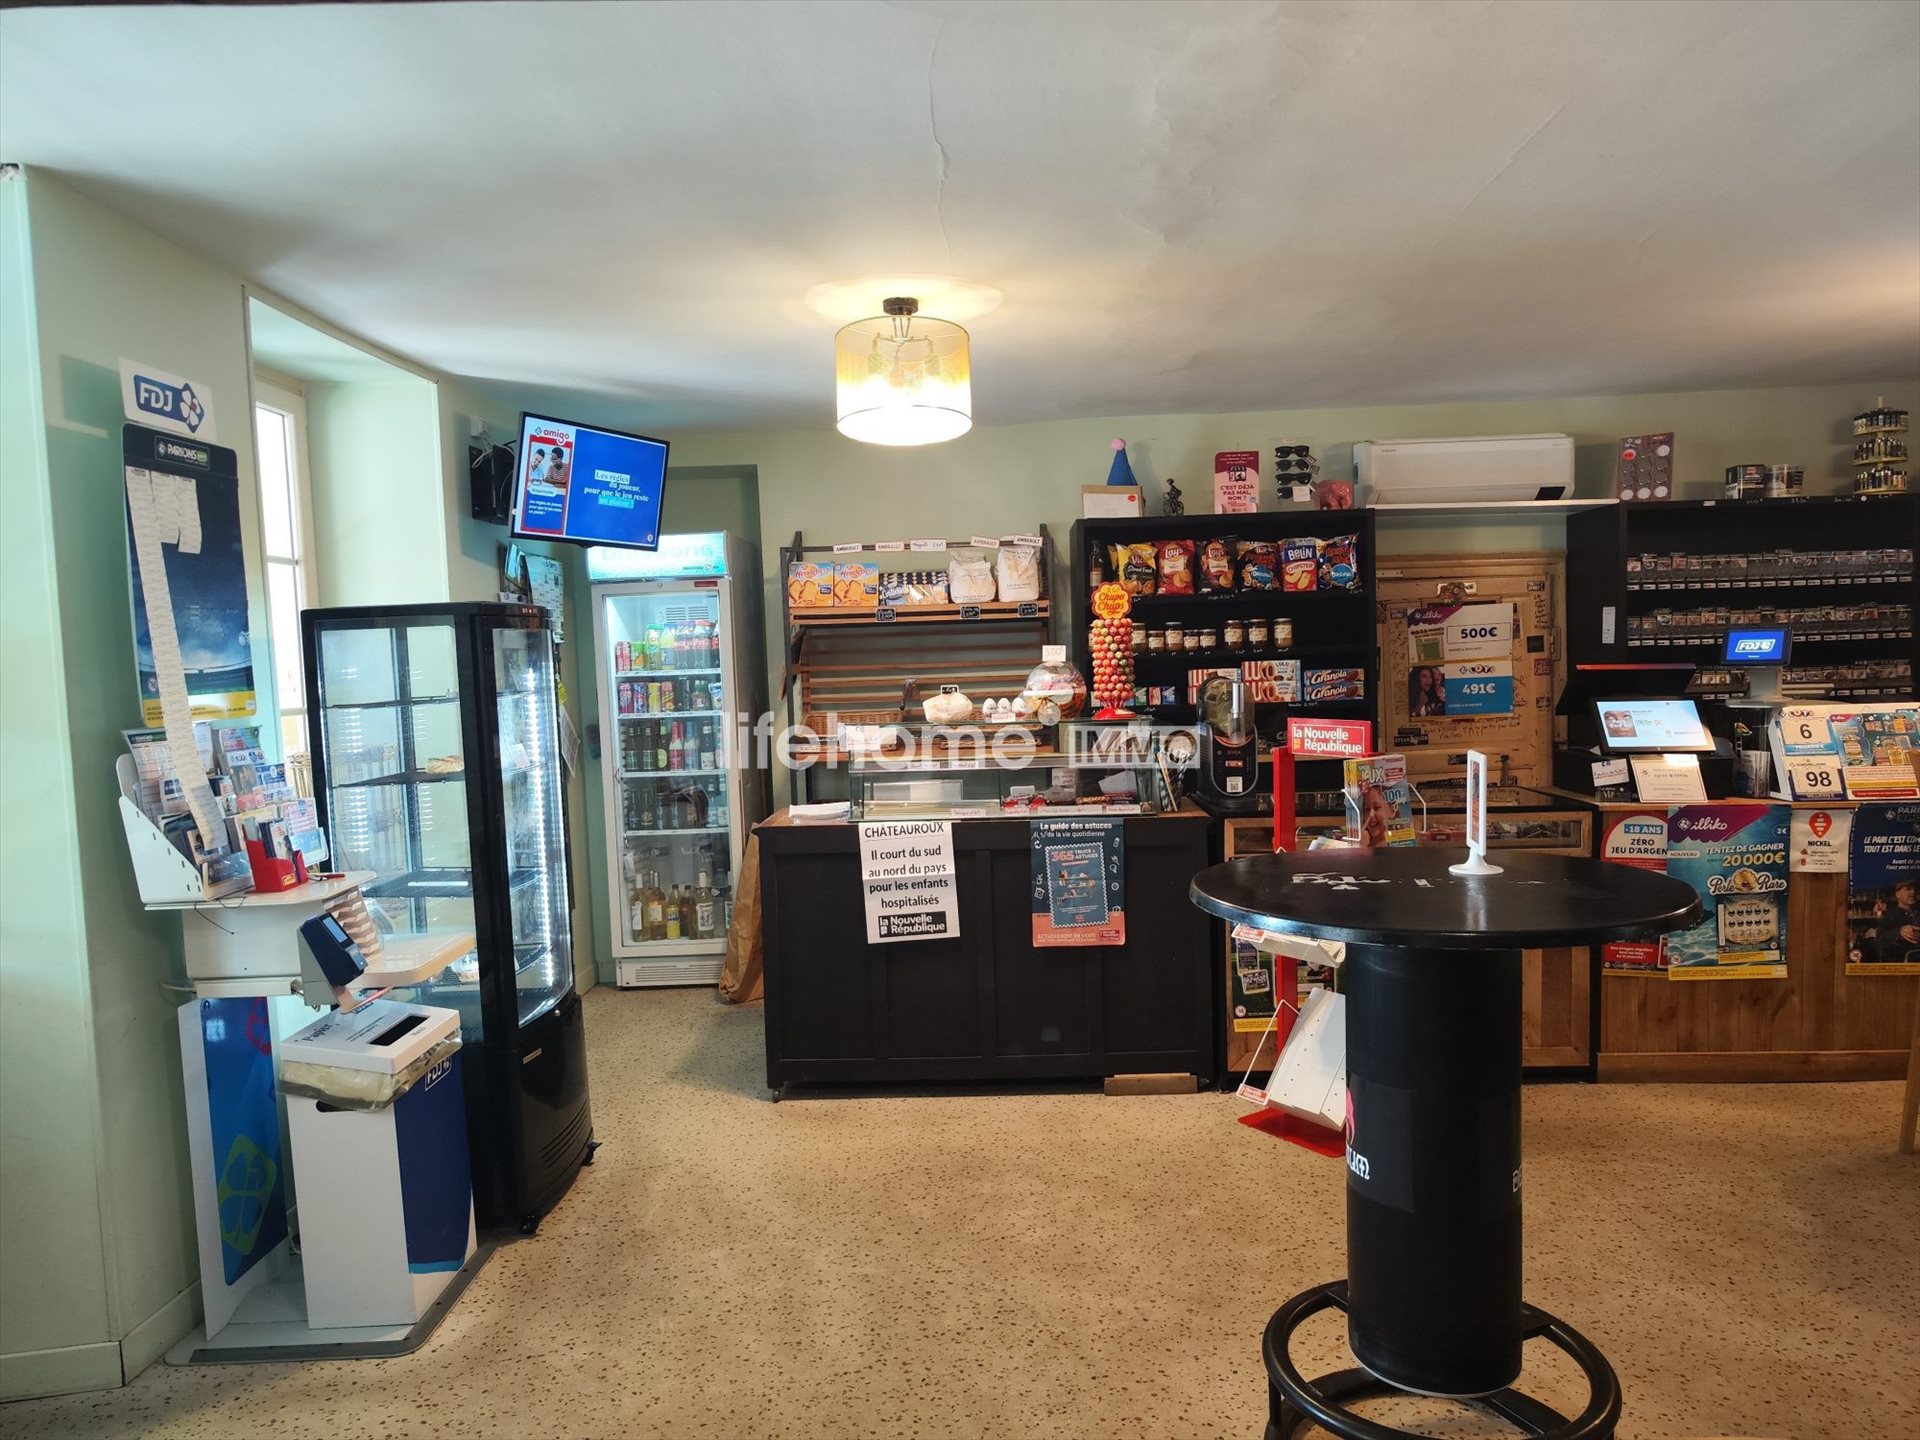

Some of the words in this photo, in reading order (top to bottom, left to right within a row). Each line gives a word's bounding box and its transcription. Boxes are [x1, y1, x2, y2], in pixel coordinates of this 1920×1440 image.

[139, 383, 173, 412] FDJ
[543, 429, 570, 444] amigo
[167, 443, 197, 460] PARIONS
[1288, 563, 1314, 573] CHIPSTER
[1099, 592, 1126, 603] Chupa
[1098, 602, 1125, 615] Chups
[1461, 627, 1497, 639] 500€
[1739, 642, 1760, 650] FDJ
[1311, 670, 1347, 685] Granola
[1311, 687, 1347, 701] Granola
[1462, 682, 1496, 695] 491€
[1293, 726, 1303, 739] la
[1304, 727, 1349, 741] Nouvelle
[1800, 724, 1812, 739] 6
[1304, 738, 1362, 754] République
[1806, 771, 1832, 787] 98
[865, 822, 944, 838] CHÂTEAUROUX
[1040, 822, 1048, 830] Le
[1050, 822, 1069, 831] guide
[1071, 822, 1083, 830] des
[1625, 825, 1640, 833] -18
[1642, 826, 1661, 834] ANS
[1691, 817, 1728, 830] illiko
[1631, 837, 1655, 846] ZÉRO
[1872, 836, 1888, 844] PARI
[1888, 835, 1906, 843] C'EST
[871, 850, 878, 861] Il
[880, 848, 906, 860] court
[909, 847, 921, 857] du
[924, 845, 941, 856] sud
[1629, 847, 1668, 855] D'ARGEN
[1706, 846, 1736, 855] TENTEZ
[1749, 843, 1785, 852] GAGNER
[1864, 845, 1880, 853] TOUT
[1881, 845, 1893, 853] EST
[868, 869, 880, 877] au
[883, 865, 906, 877] nord
[909, 864, 921, 874] du
[924, 864, 947, 875] pays
[869, 883, 892, 894] pour
[895, 881, 909, 891] les
[911, 879, 949, 890] enfants
[1710, 878, 1736, 894] Perle
[1757, 874, 1786, 890] Rare
[881, 895, 940, 909] hospitalisés
[880, 917, 888, 926] la
[890, 914, 933, 926] Nouvelle
[890, 923, 946, 935] République
[302, 1023, 333, 1041] Papier
[427, 1060, 443, 1084] FDJ
